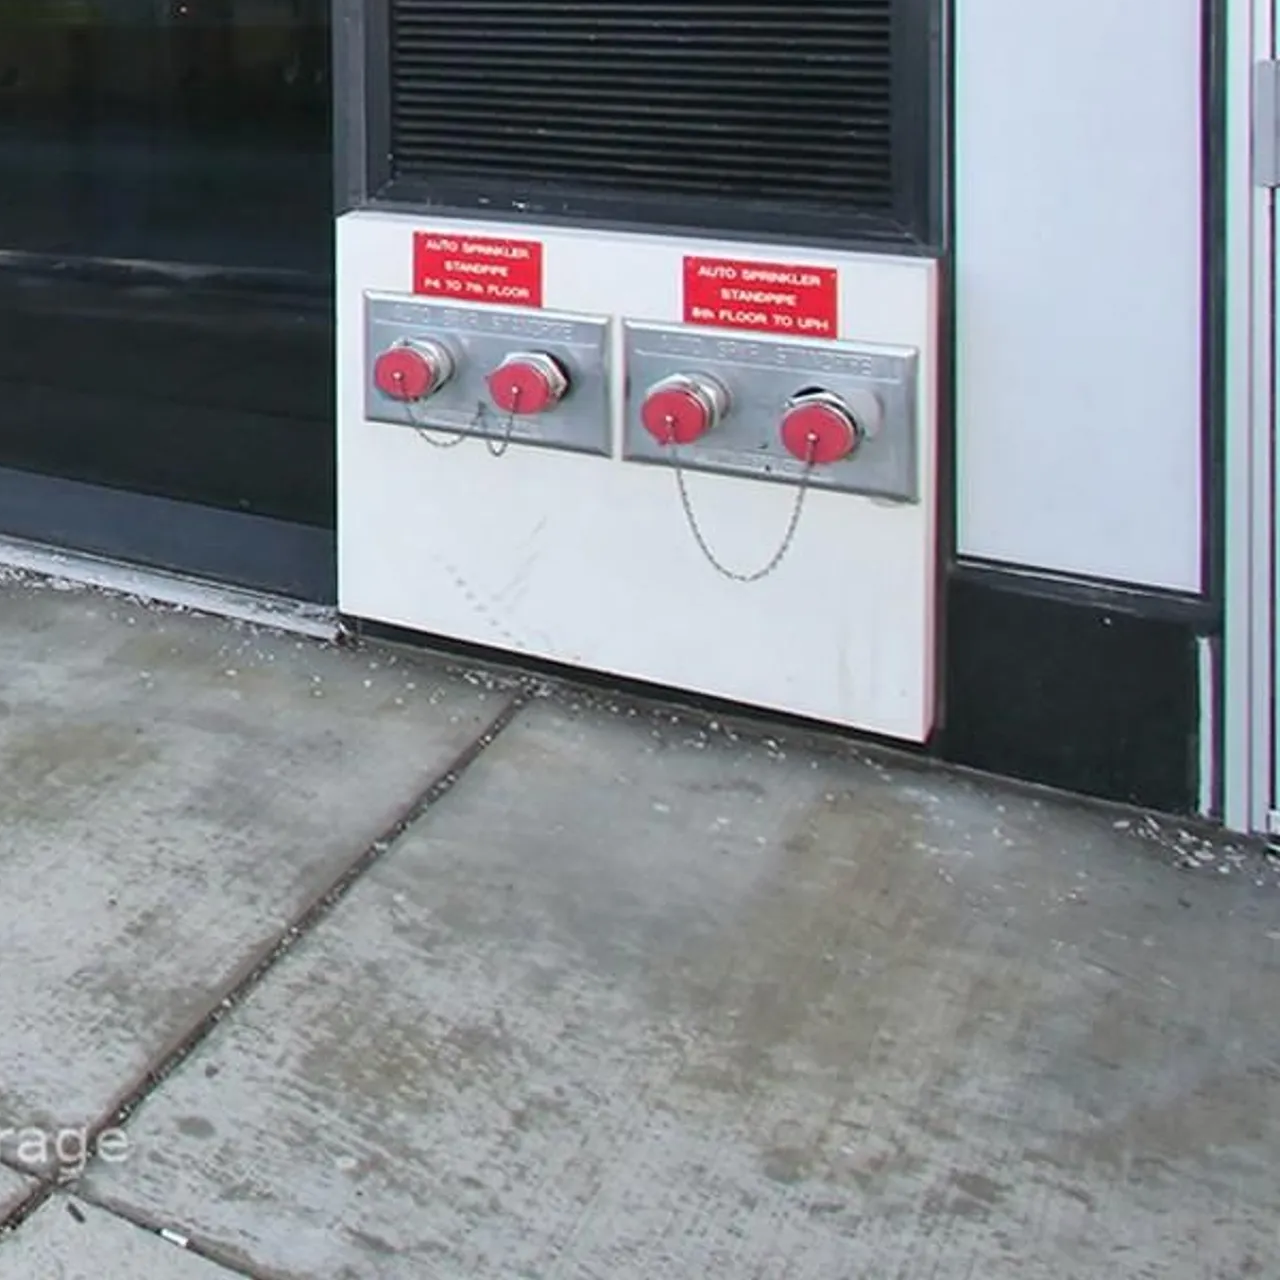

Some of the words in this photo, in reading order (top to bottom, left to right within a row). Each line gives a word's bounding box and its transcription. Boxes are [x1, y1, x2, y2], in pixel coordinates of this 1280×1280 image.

[425, 239, 459, 253] AUTO
[461, 241, 531, 260] SPRINKLER
[443, 260, 510, 278] STANDPIPE
[697, 266, 737, 280] AUTO
[741, 269, 821, 287] SPRINKLER
[445, 280, 462, 292] TO
[486, 283, 530, 298] FLOOR
[720, 288, 798, 306] STANDPIPE
[718, 309, 768, 325] FLOOR
[772, 313, 793, 328] TO
[796, 316, 830, 331] UPH
